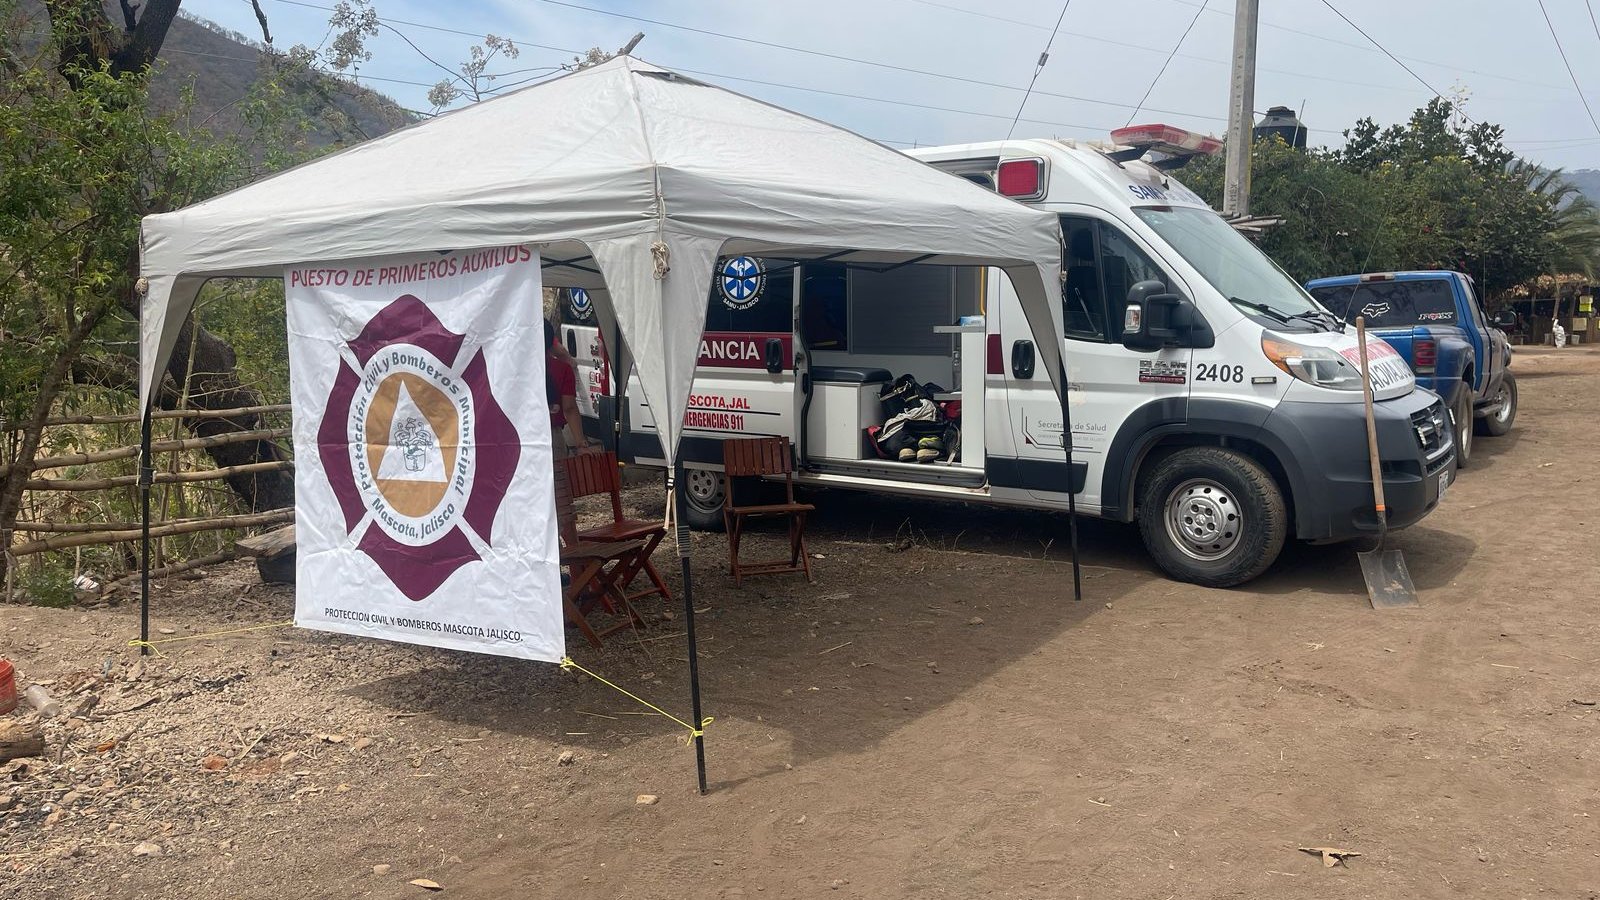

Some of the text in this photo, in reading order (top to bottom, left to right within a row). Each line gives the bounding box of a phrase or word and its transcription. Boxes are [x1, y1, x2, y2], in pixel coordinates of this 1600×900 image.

[291, 245, 531, 287] PUESTO DE PRIMEROS AUXILIOS
[698, 340, 760, 360] ANCIA
[1195, 363, 1243, 382] 2408
[353, 351, 471, 496] Protección Civil y Bomberos Municipal
[684, 412, 744, 430] MERGENCIAS 911
[1086, 423, 1107, 431] Salud
[372, 497, 455, 539] Mascota, Jalisco
[325, 607, 523, 642] PROTECCION CIVIL Y BOMBEROS MASCOTA JALISCO.
